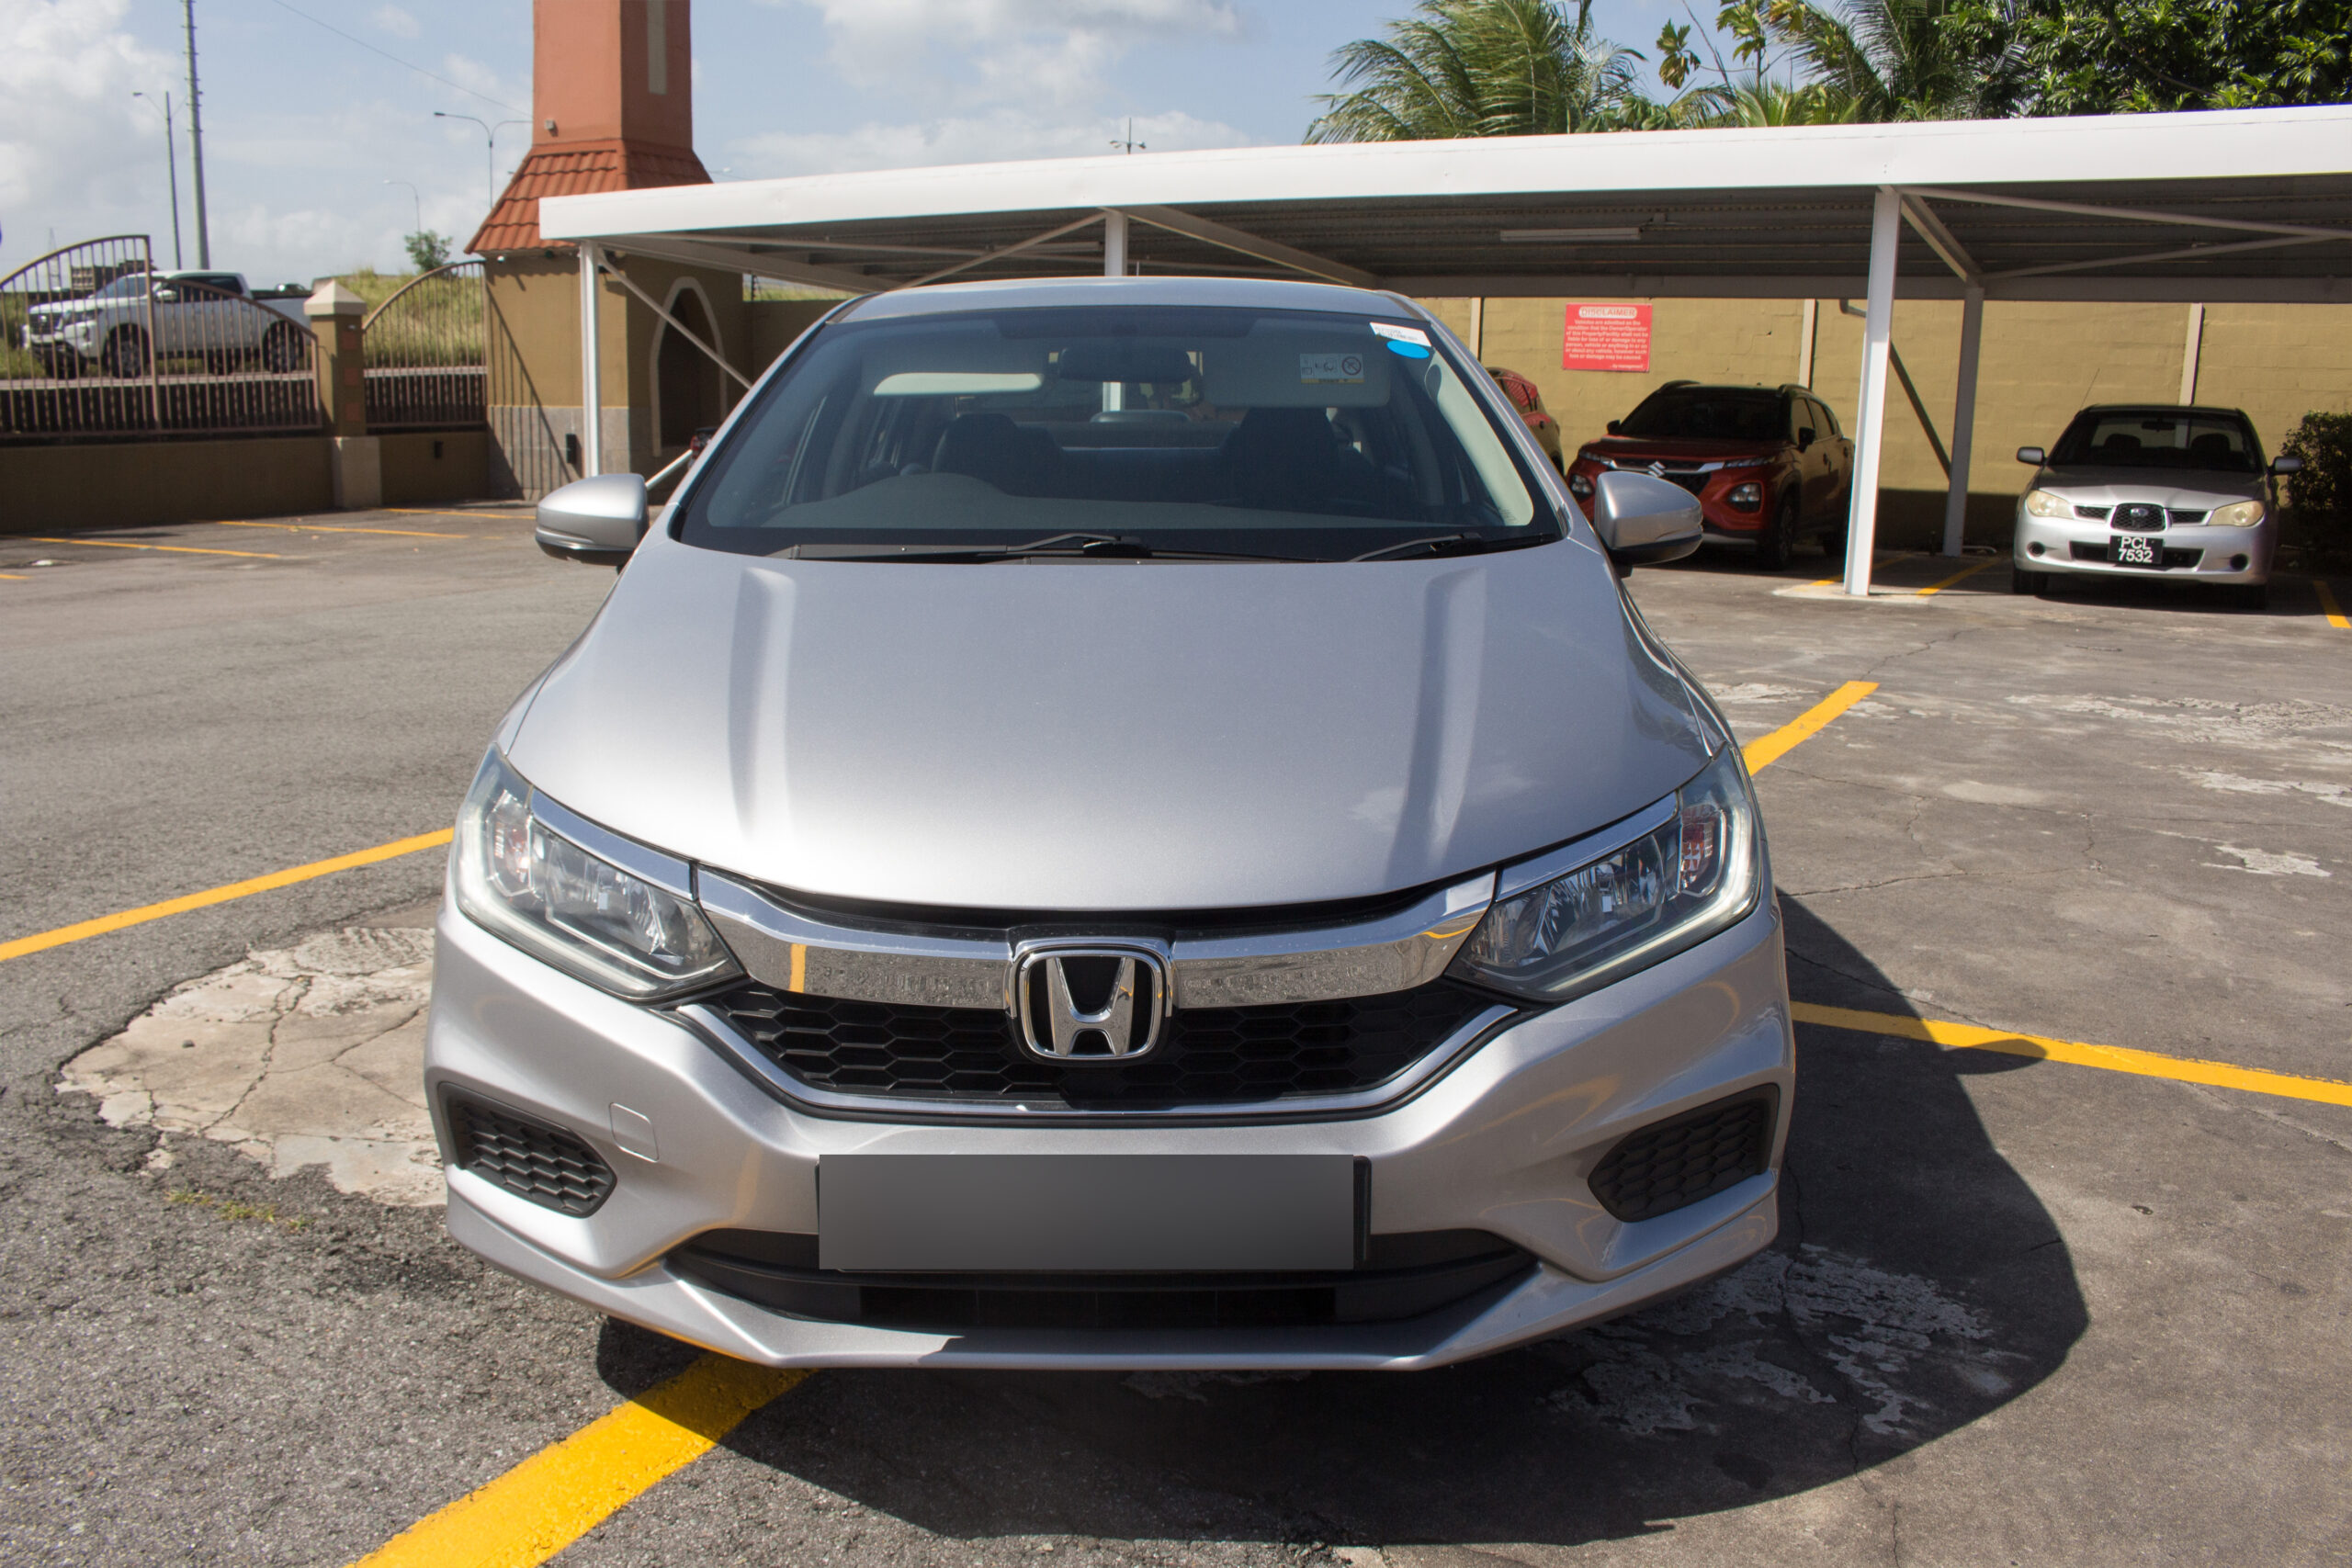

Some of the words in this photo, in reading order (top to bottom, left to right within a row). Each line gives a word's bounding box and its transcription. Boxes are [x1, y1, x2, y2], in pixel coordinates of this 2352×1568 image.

[1582, 308, 1634, 316] DISCLAIMER
[2120, 536, 2151, 549] PCL
[2118, 548, 2153, 562] 7532
